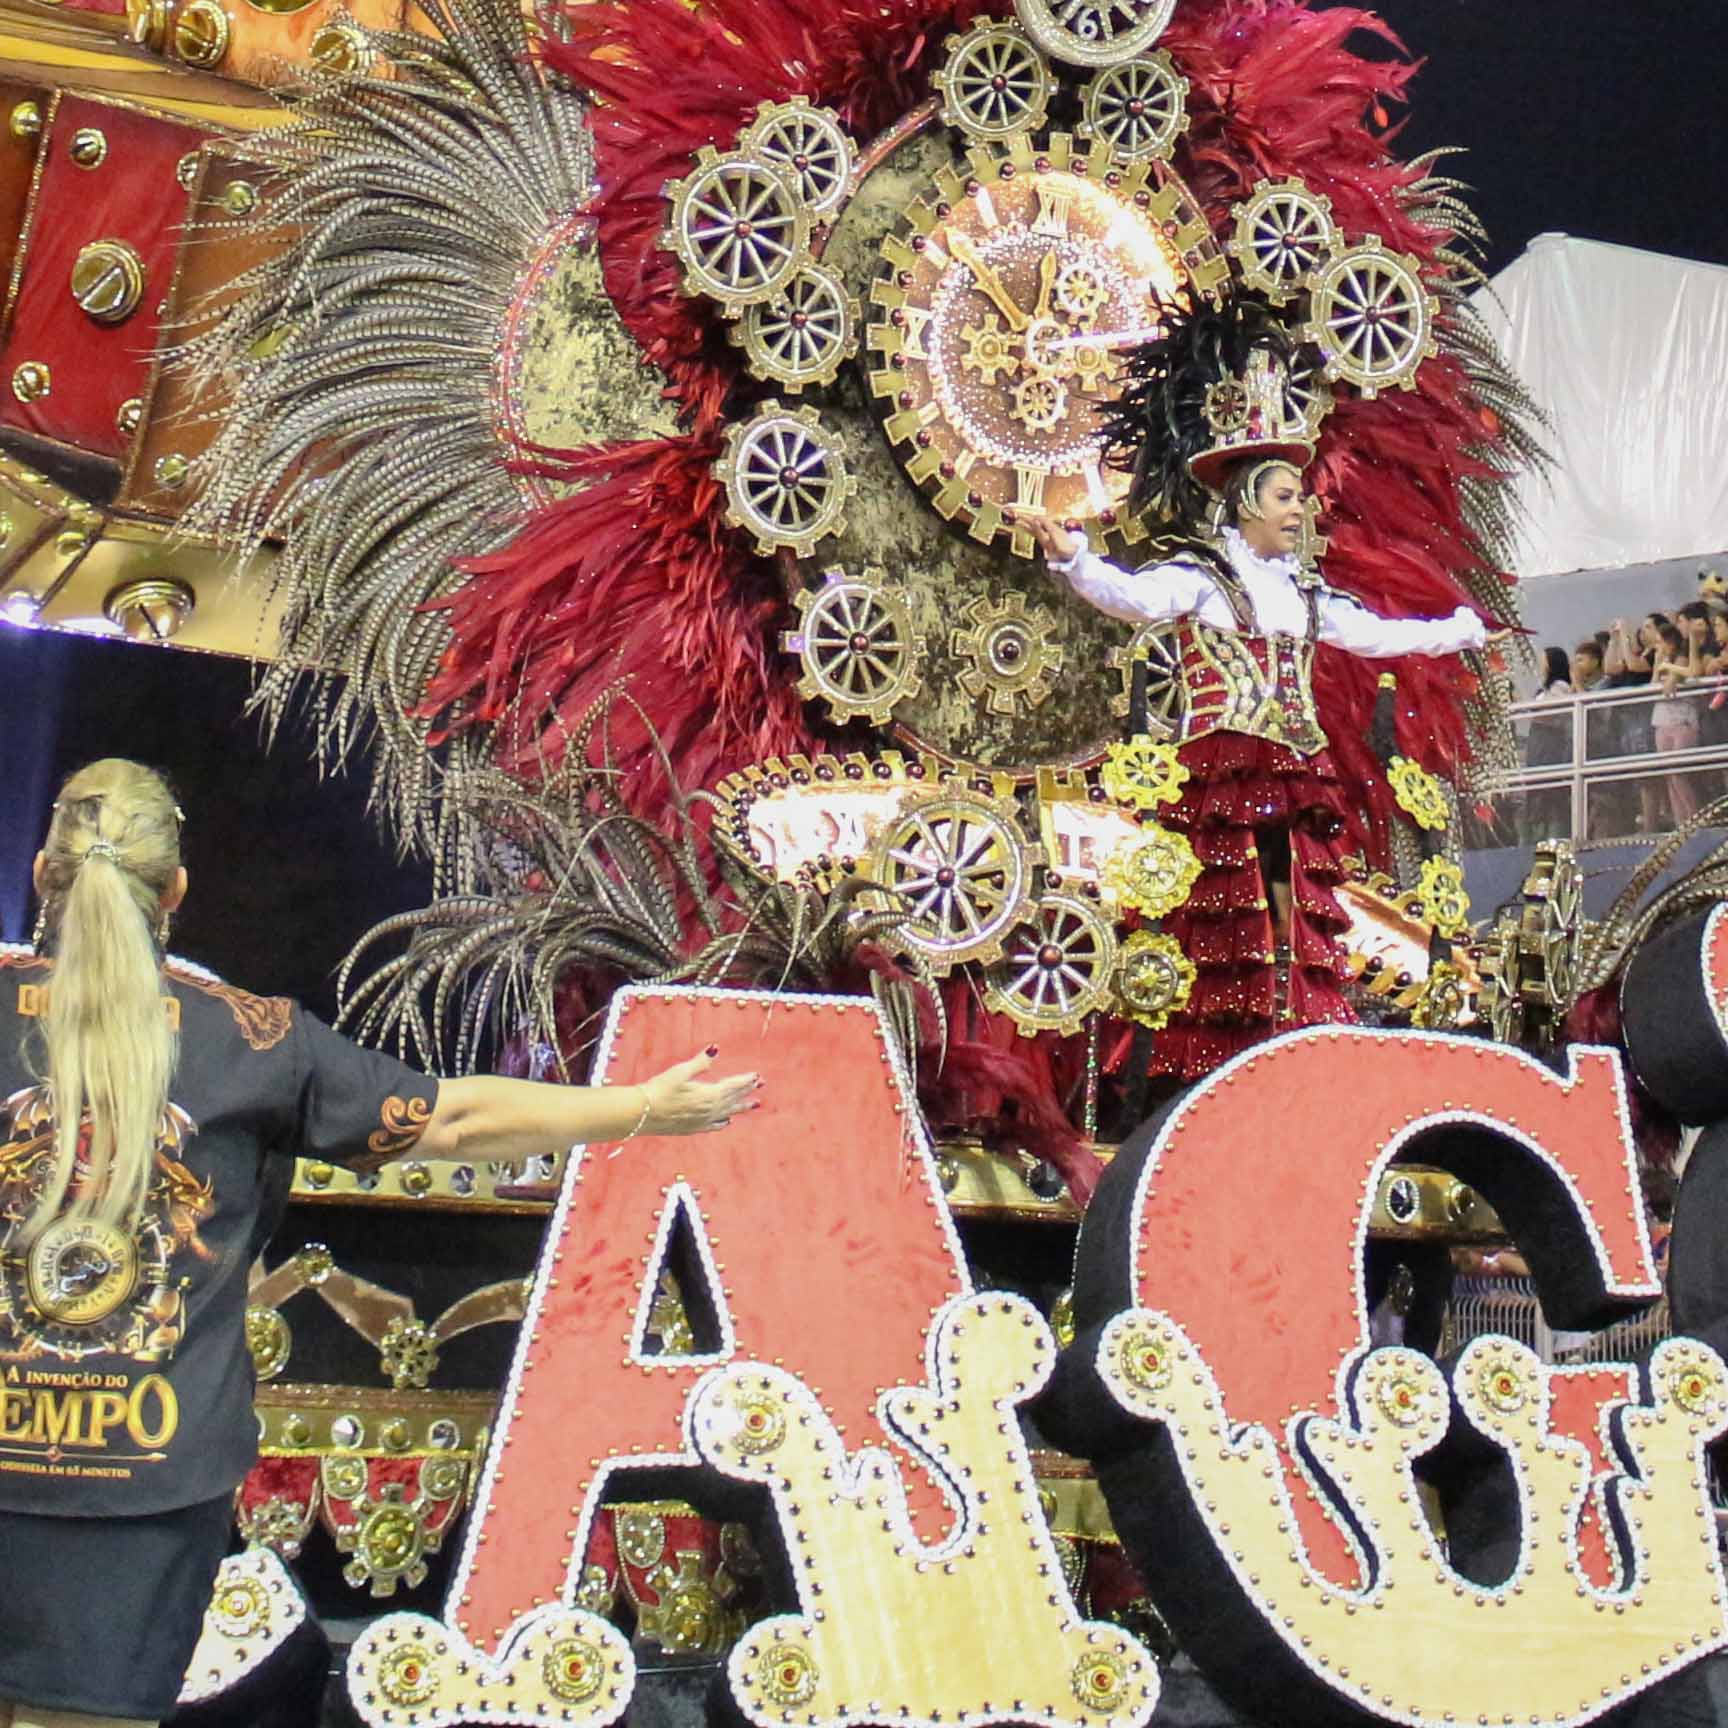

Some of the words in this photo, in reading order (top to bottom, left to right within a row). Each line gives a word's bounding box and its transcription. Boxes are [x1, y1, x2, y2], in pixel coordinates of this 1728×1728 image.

[1078, 10, 1098, 41] 6
[7, 1365, 20, 1384] A
[26, 1369, 102, 1389] INVENÇÃO
[104, 1374, 129, 1389] DO
